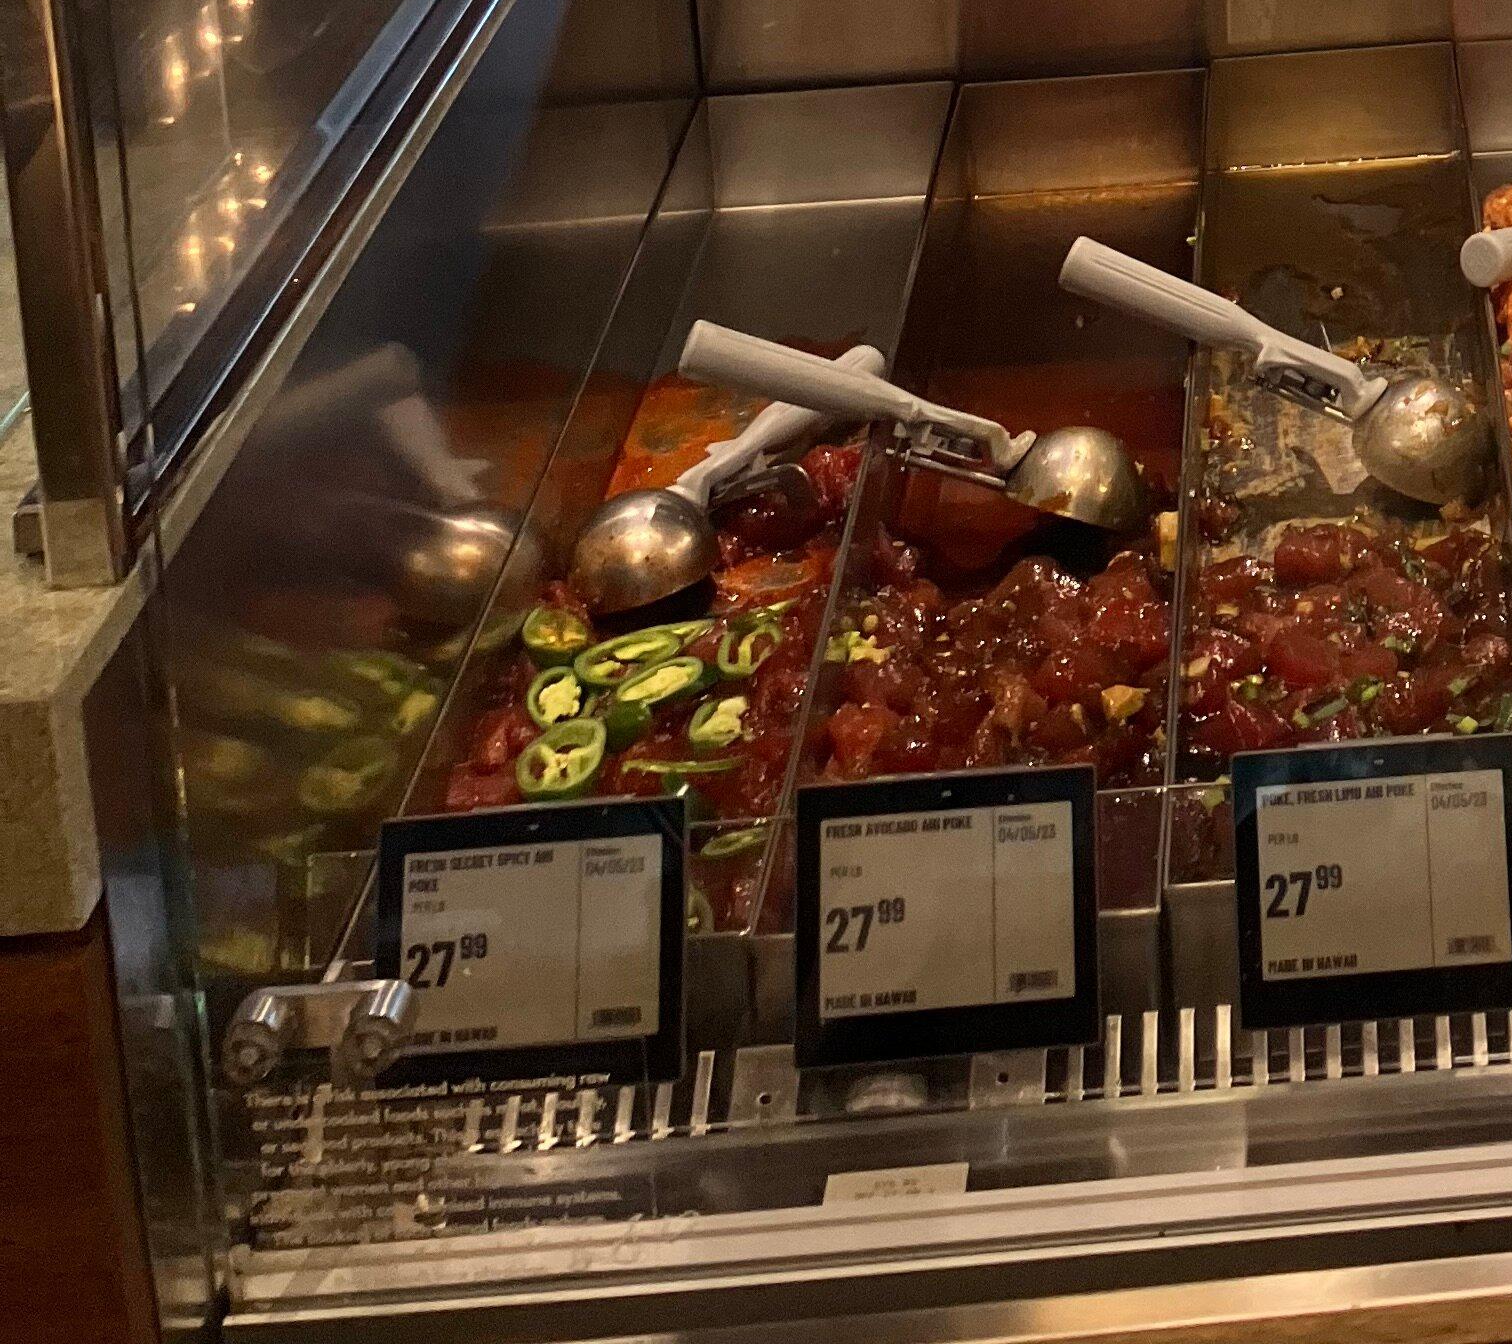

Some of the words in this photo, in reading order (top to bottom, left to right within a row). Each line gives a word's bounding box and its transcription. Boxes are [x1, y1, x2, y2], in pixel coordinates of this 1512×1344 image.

[1297, 789, 1333, 805] FRESH
[1335, 787, 1362, 802] LIMU
[1386, 782, 1415, 797] POKE
[826, 823, 862, 839] FRESH
[864, 819, 918, 836] AVOCADO
[942, 814, 973, 831] POKE
[497, 851, 531, 867] SPICY
[408, 878, 439, 893] POKE
[1267, 958, 1299, 974] MADE
[1302, 957, 1315, 972] IN
[1317, 953, 1358, 970] HAWAII
[825, 993, 856, 1010] MADE
[859, 992, 872, 1008] IN
[874, 989, 917, 1007] HAWAII
[451, 1077, 486, 1094] with
[489, 1074, 577, 1091] consuming
